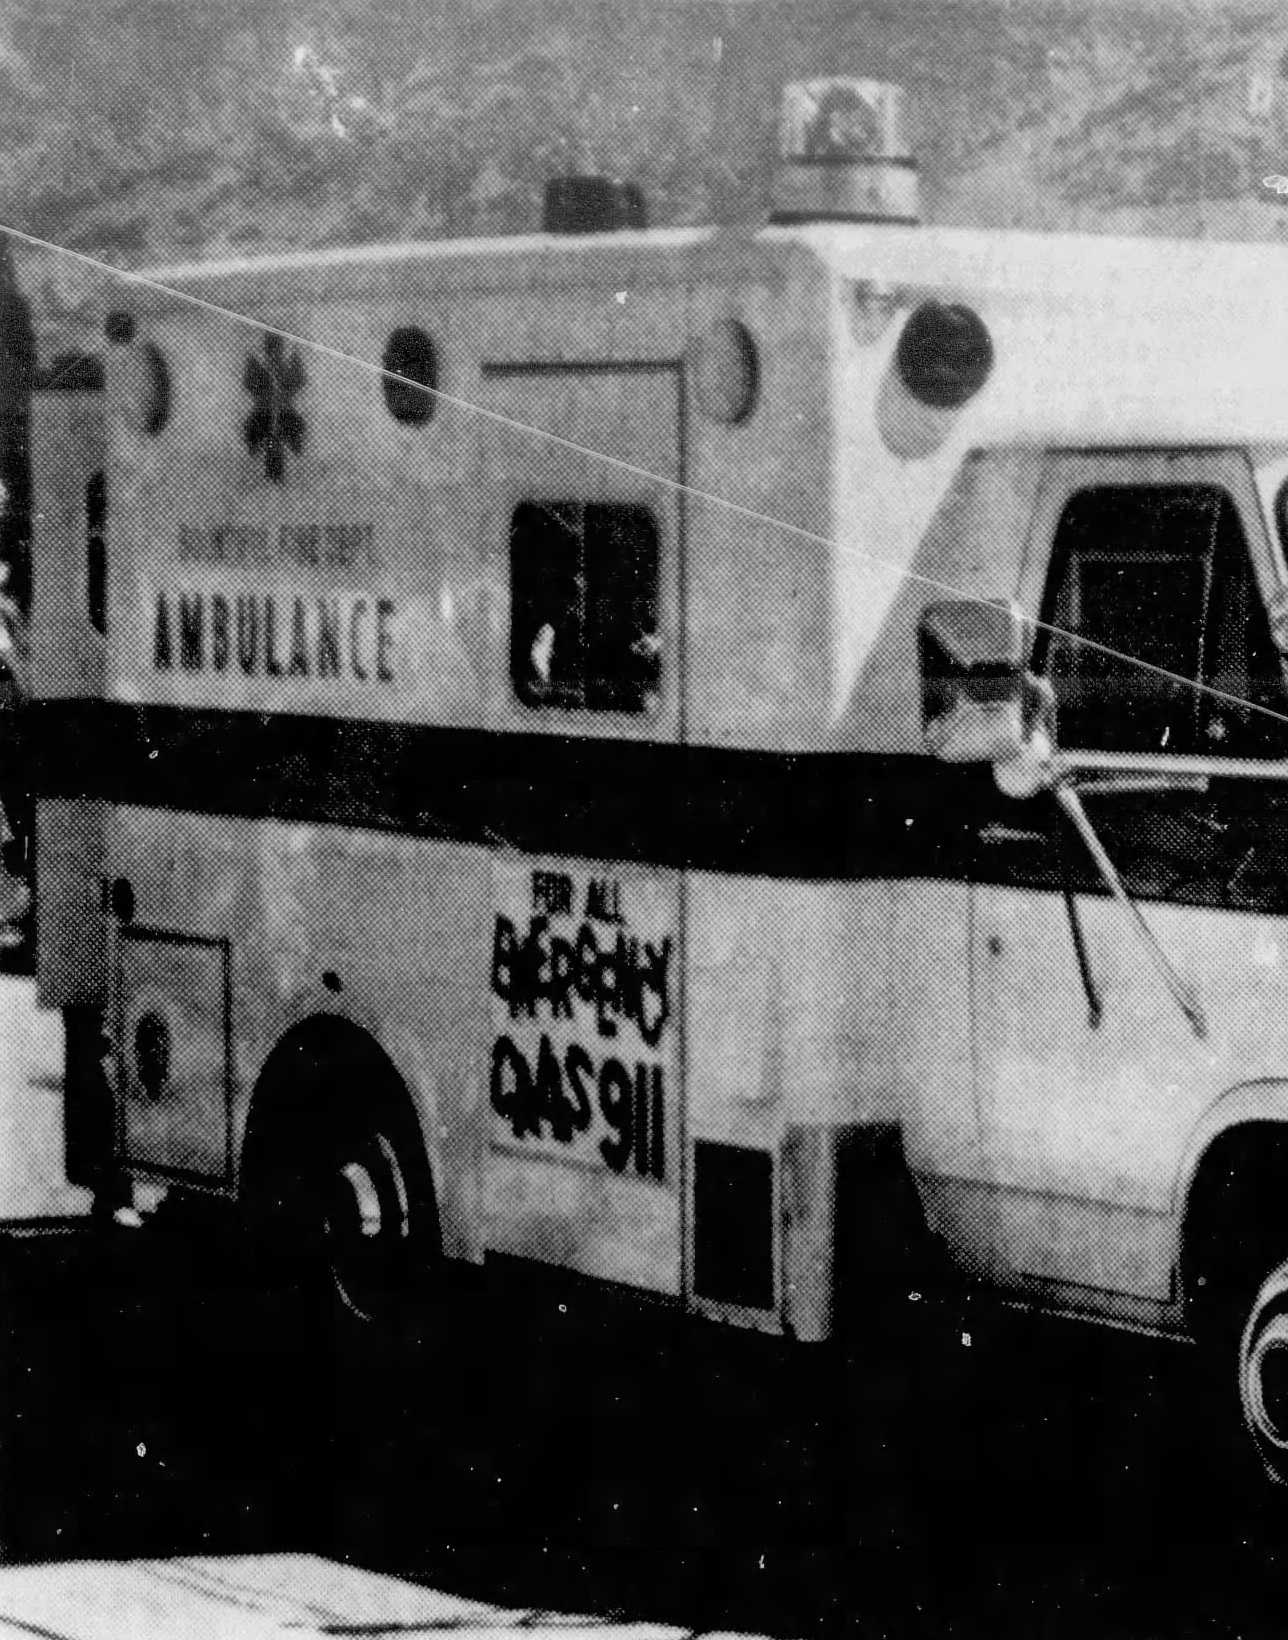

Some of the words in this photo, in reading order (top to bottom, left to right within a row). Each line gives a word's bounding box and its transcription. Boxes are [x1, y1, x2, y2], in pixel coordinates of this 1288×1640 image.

[154, 593, 395, 684] AMBULANCE
[532, 870, 573, 915] FOR
[584, 878, 626, 925] ALL
[598, 1058, 667, 1182] 911
